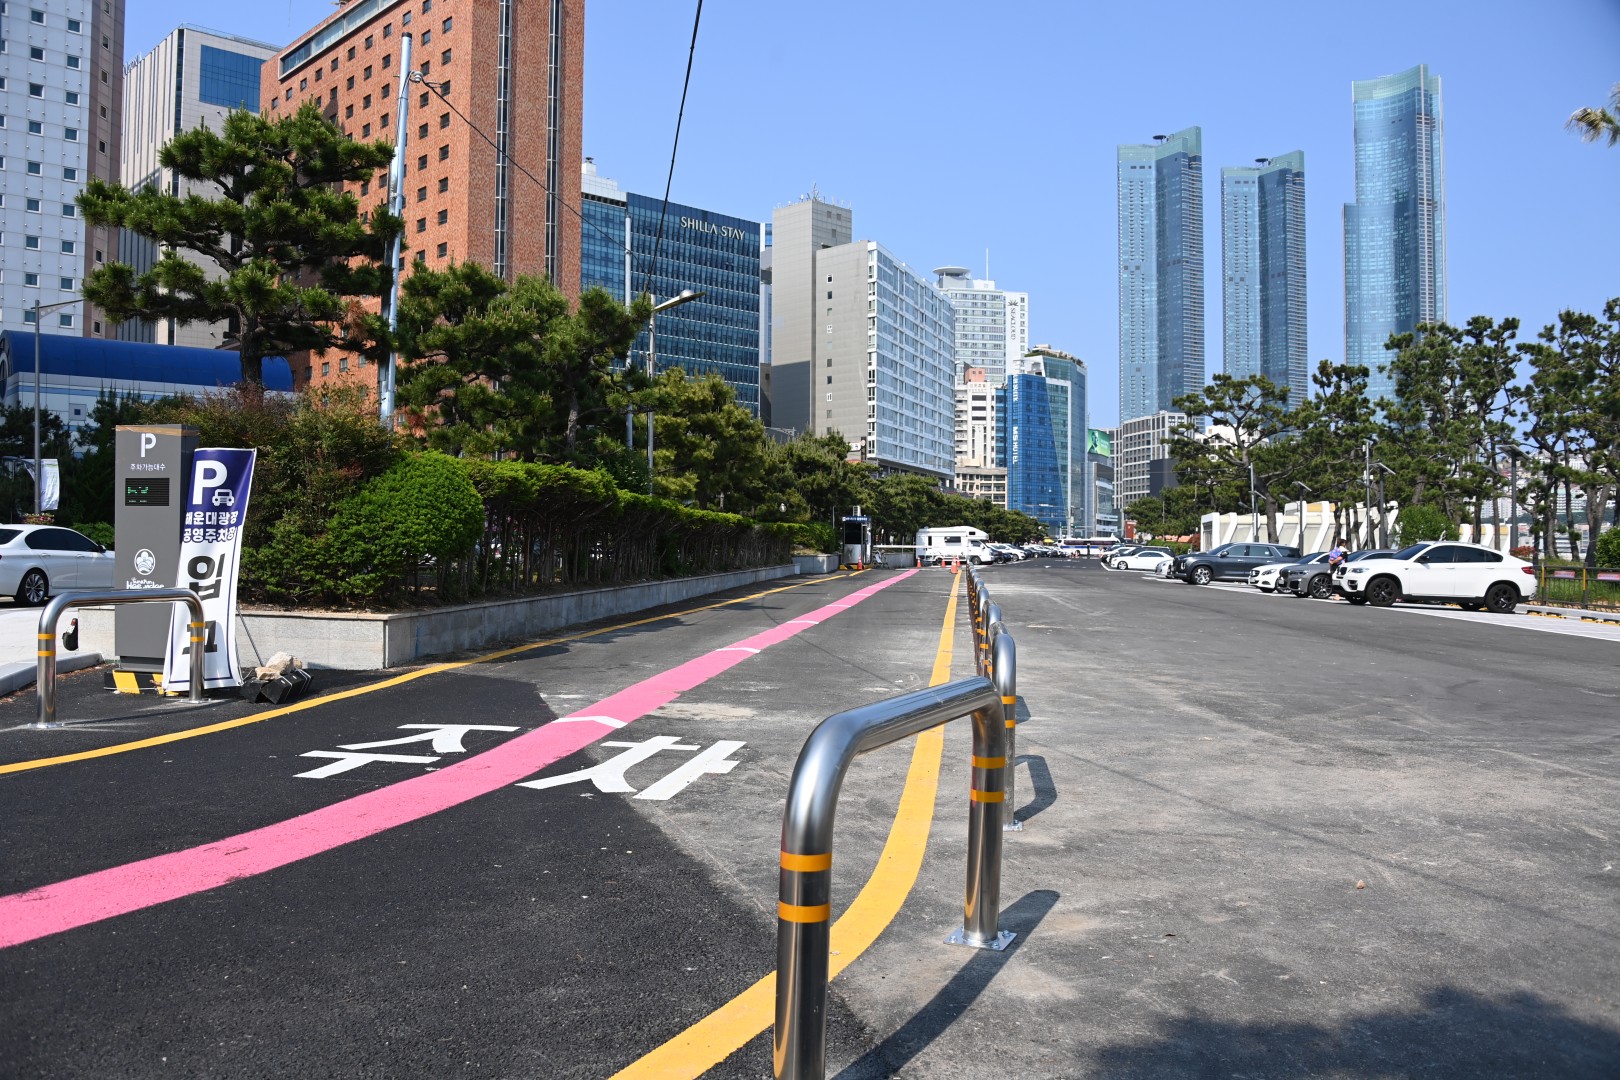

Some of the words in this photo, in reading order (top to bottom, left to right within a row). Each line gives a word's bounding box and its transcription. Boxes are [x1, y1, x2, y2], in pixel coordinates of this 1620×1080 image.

[680, 216, 717, 235] SHILLA
[720, 225, 745, 240] STAY
[141, 433, 156, 457] P
[192, 460, 227, 505] P
[185, 510, 239, 525] 해운대광장
[183, 526, 236, 543] 공영주차장
